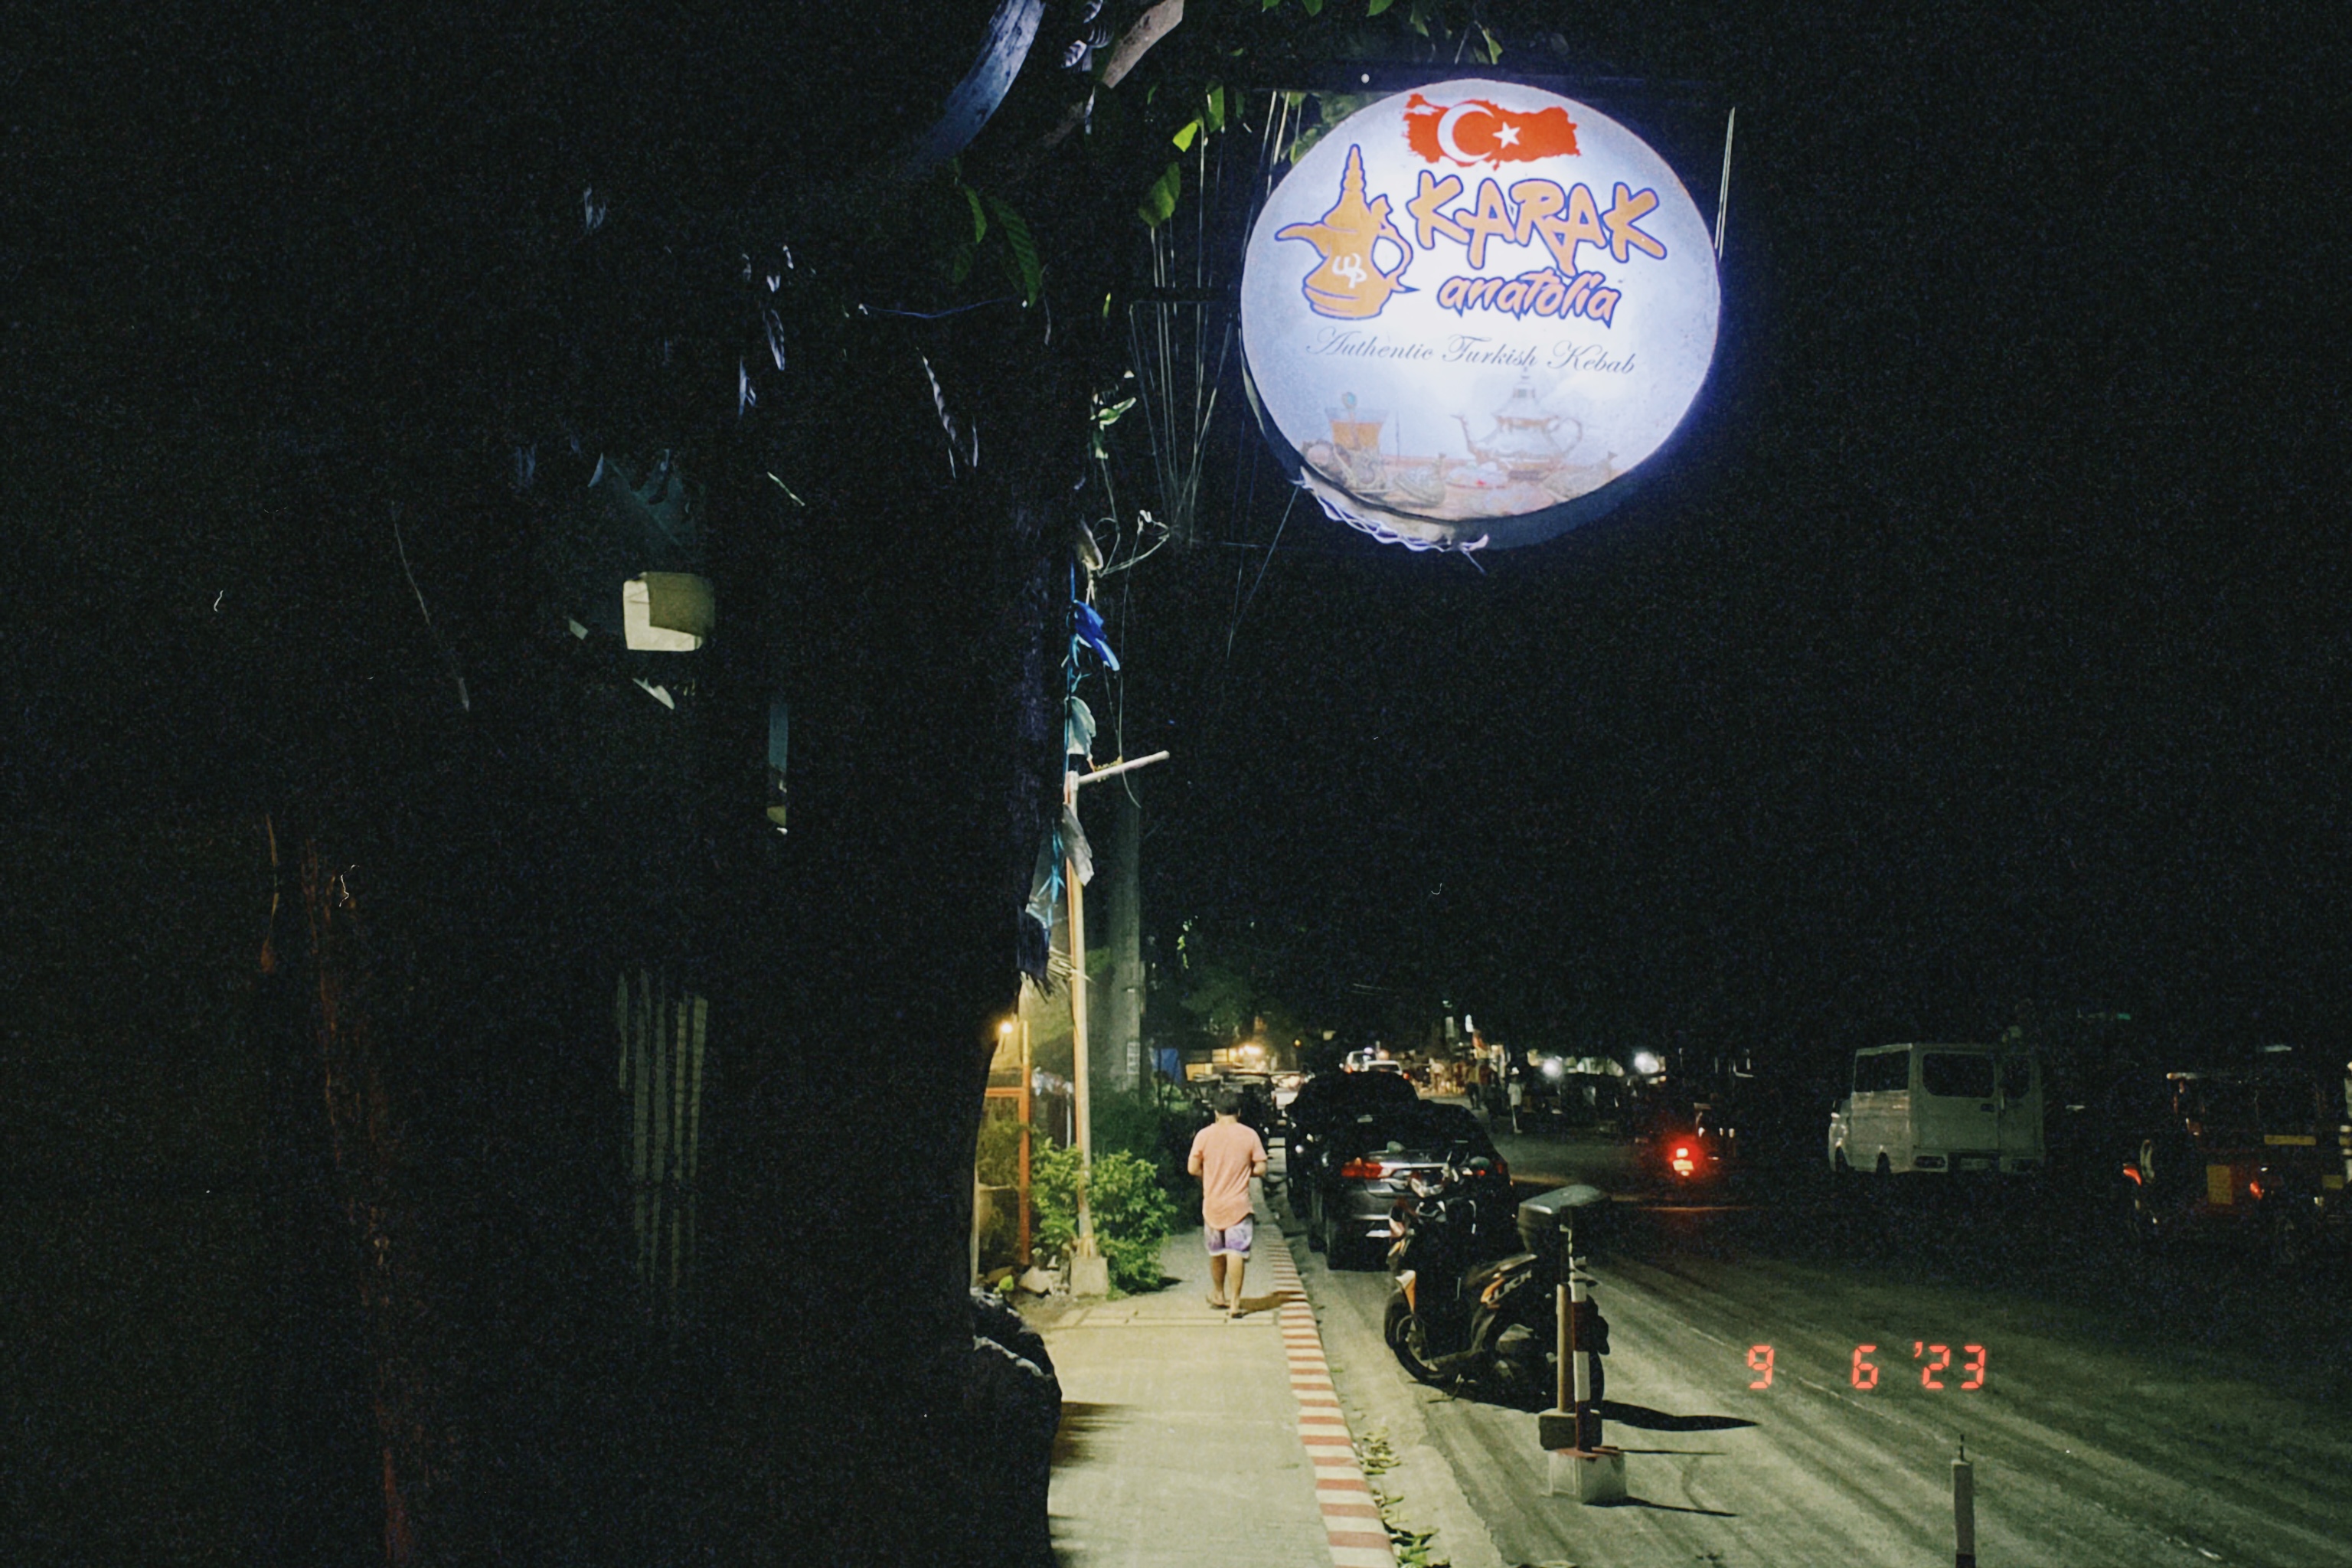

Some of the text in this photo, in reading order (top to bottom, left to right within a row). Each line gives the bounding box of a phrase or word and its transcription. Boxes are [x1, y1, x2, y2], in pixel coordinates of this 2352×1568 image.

[1406, 169, 1668, 278] KARAK
[1437, 266, 1622, 329] anatolia
[1305, 326, 1637, 374] Authentic Turkish Kebab
